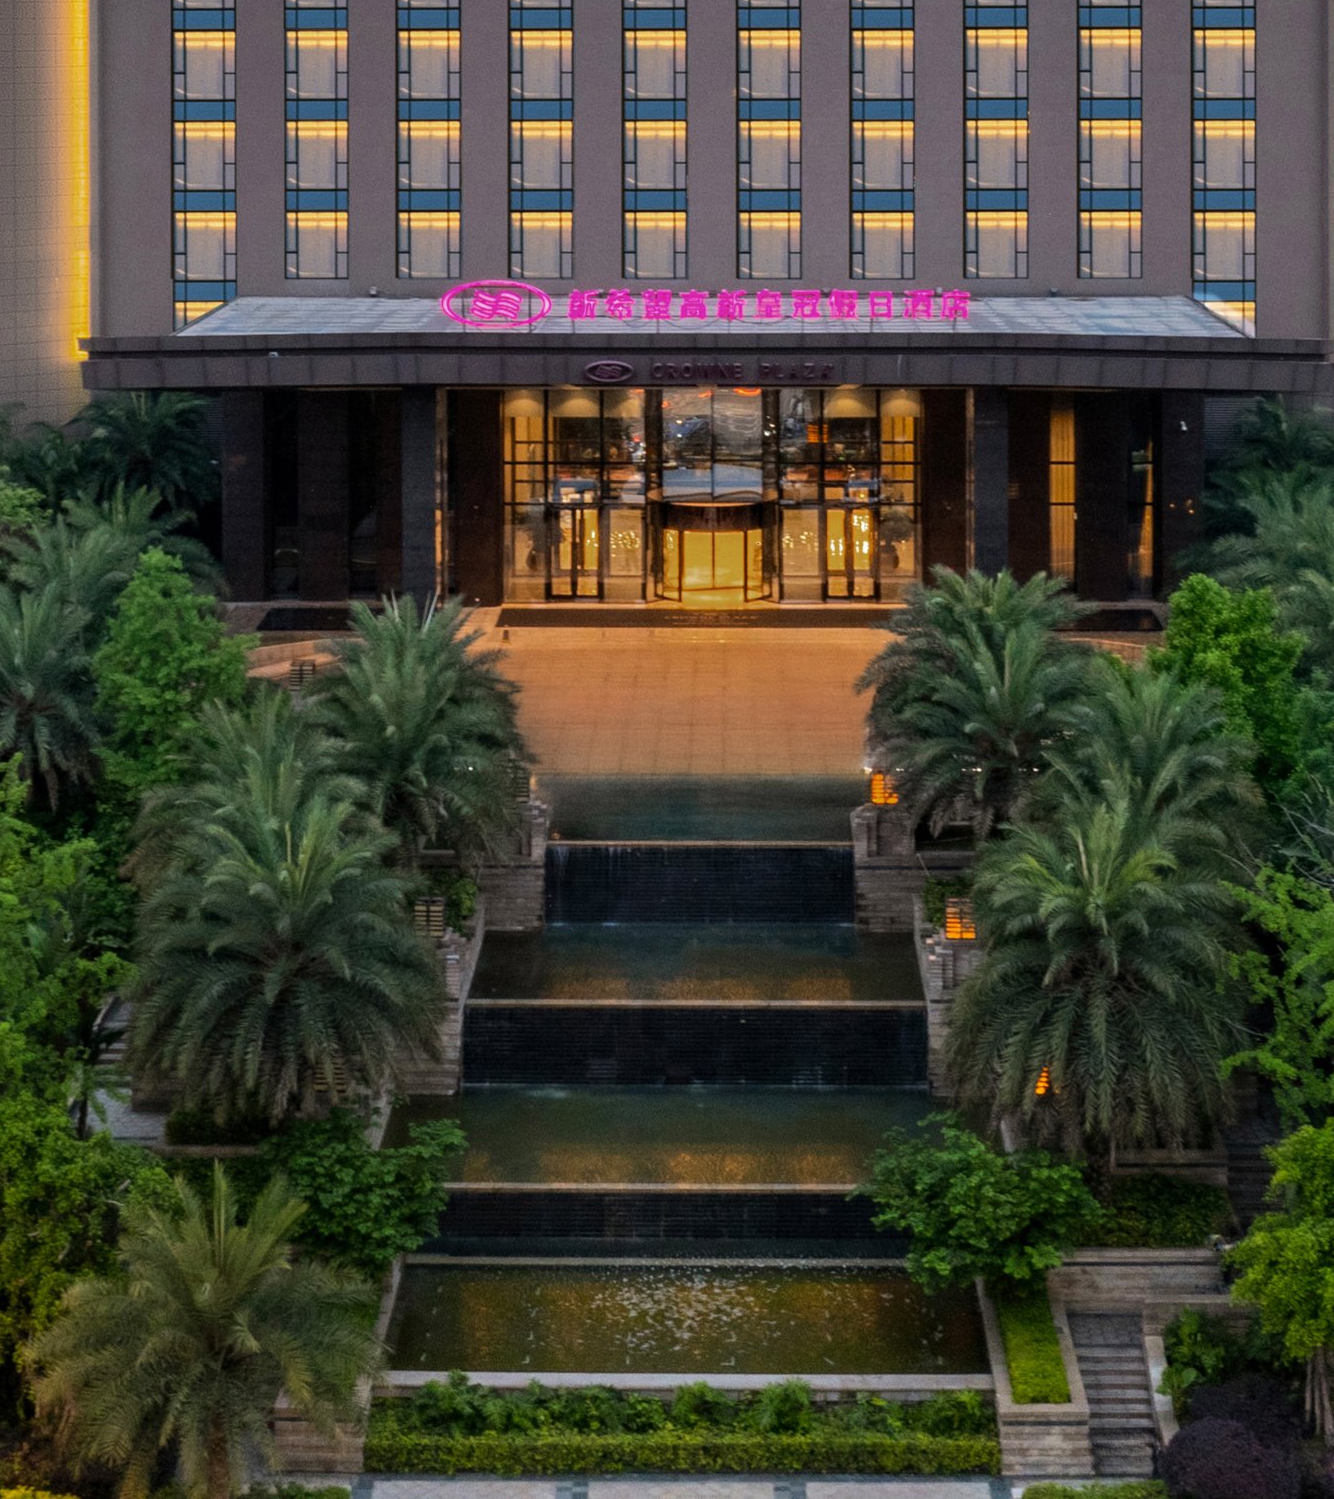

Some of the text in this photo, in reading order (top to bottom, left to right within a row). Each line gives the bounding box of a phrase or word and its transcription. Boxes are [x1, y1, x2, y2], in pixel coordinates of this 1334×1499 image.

[568, 288, 971, 320] 新希望高新皇冠假日酒店
[651, 362, 742, 379] CROWNE
